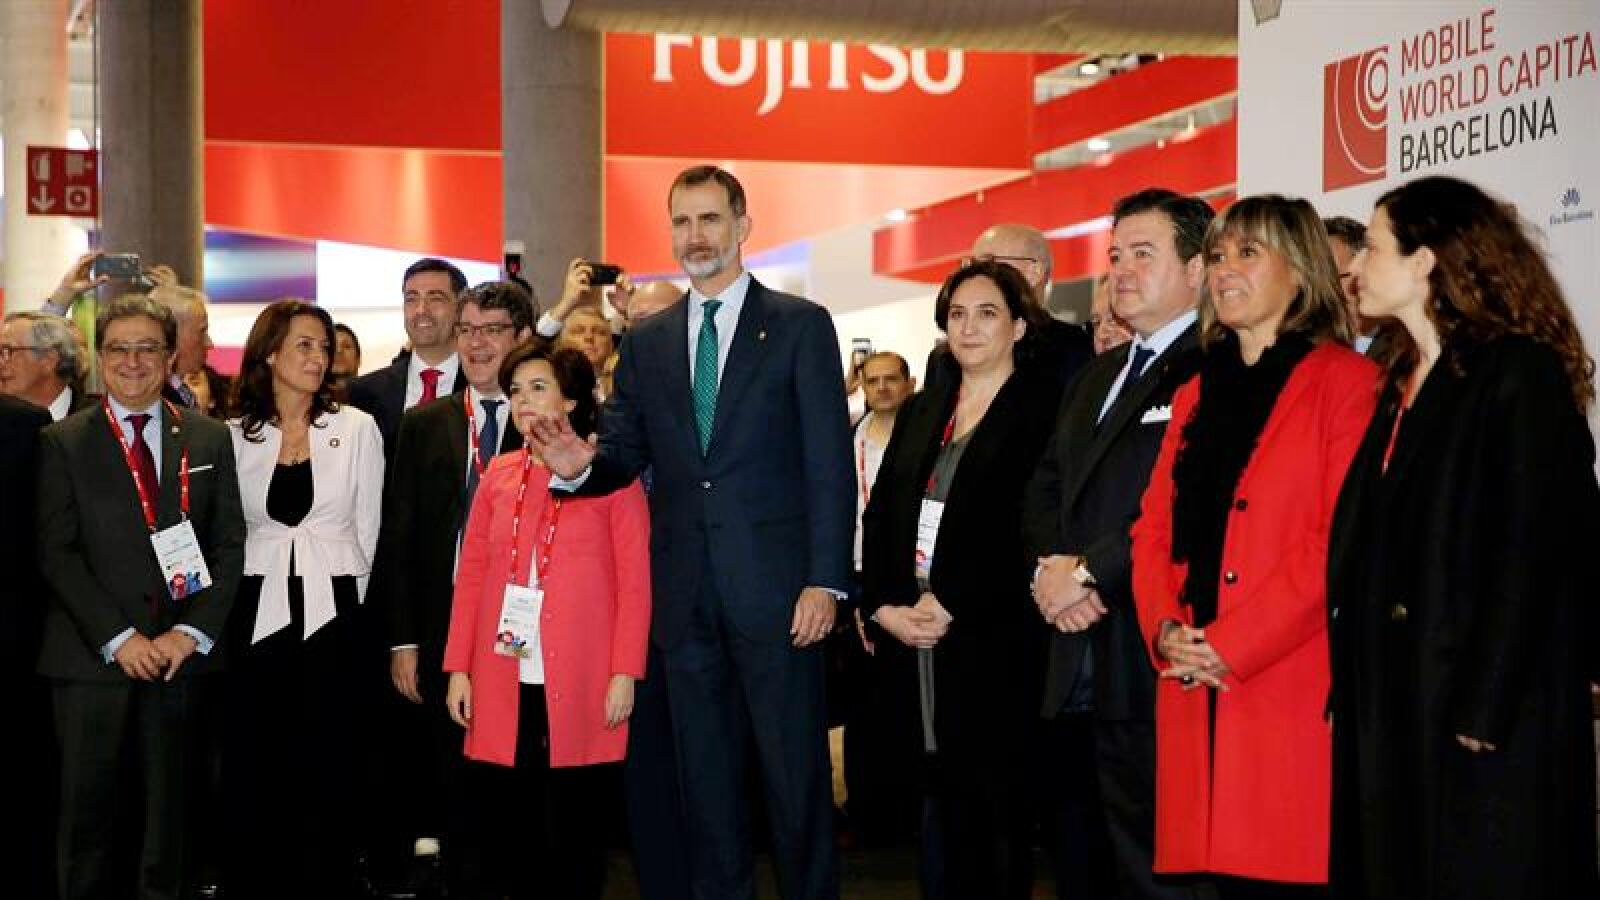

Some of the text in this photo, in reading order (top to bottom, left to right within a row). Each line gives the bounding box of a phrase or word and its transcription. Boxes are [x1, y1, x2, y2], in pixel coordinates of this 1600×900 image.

[1401, 9, 1495, 76] MOBILE
[1400, 63, 1489, 123] WORLD
[1401, 95, 1558, 173] BARCELONA
